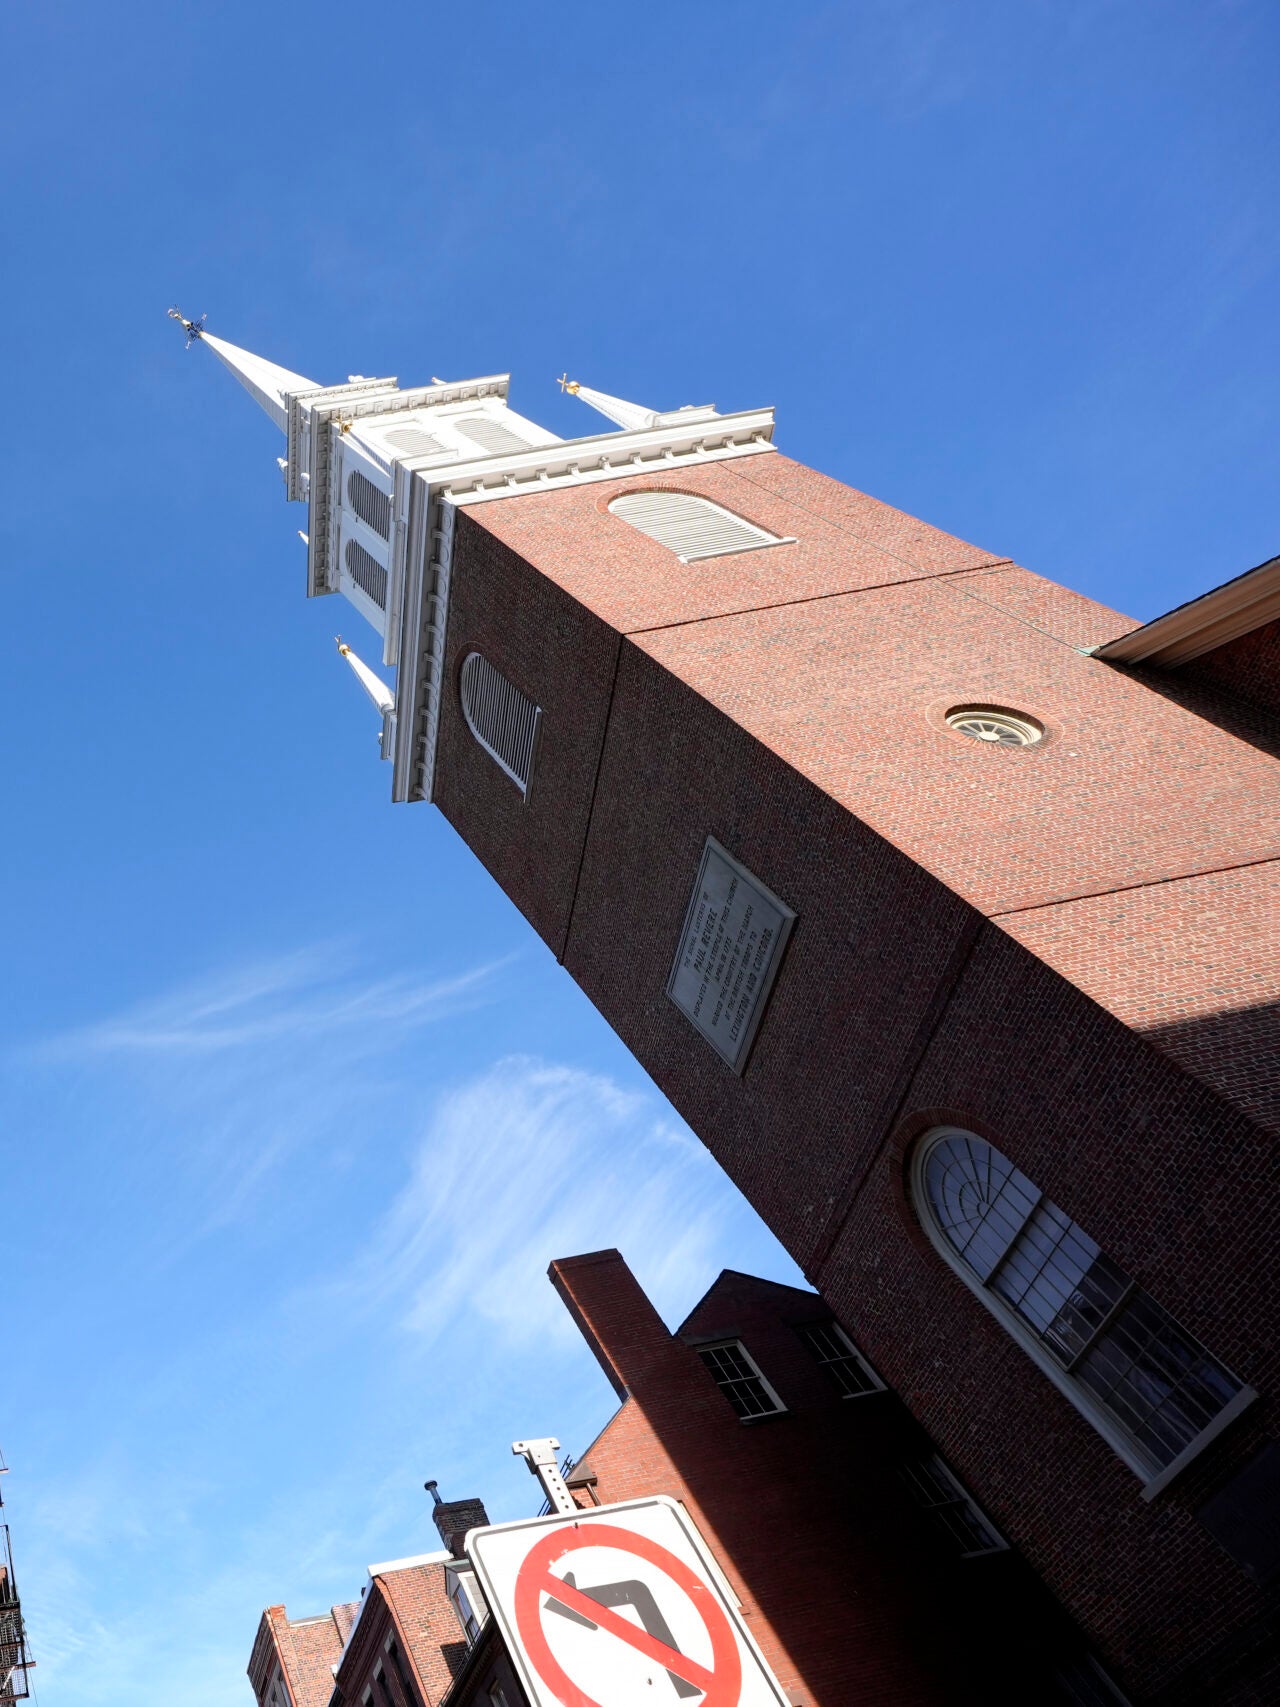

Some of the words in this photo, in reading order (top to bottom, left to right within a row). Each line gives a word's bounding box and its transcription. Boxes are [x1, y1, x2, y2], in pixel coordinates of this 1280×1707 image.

[726, 876, 739, 907] CHURCH
[717, 922, 725, 934] OF
[720, 904, 730, 925] THIS
[741, 903, 753, 931] MARCH
[693, 945, 706, 973] PAUL
[700, 906, 717, 947] REVERE
[709, 931, 722, 962] STEEPLE
[733, 943, 740, 956] OF
[736, 928, 745, 946] THE
[702, 973, 709, 984] IN
[705, 959, 713, 977] THE
[714, 960, 724, 982] APRIL
[723, 954, 737, 987] COUNTRY
[727, 995, 735, 1011] THE
[731, 968, 744, 999] BRITISH
[740, 941, 753, 970] TROOPS
[749, 929, 757, 943] TO
[692, 981, 707, 1018] DISPLAYED
[719, 983, 727, 1001] THE
[711, 999, 722, 1027] WARNED
[728, 992, 750, 1043] LEXINGTON
[745, 971, 757, 994] AND
